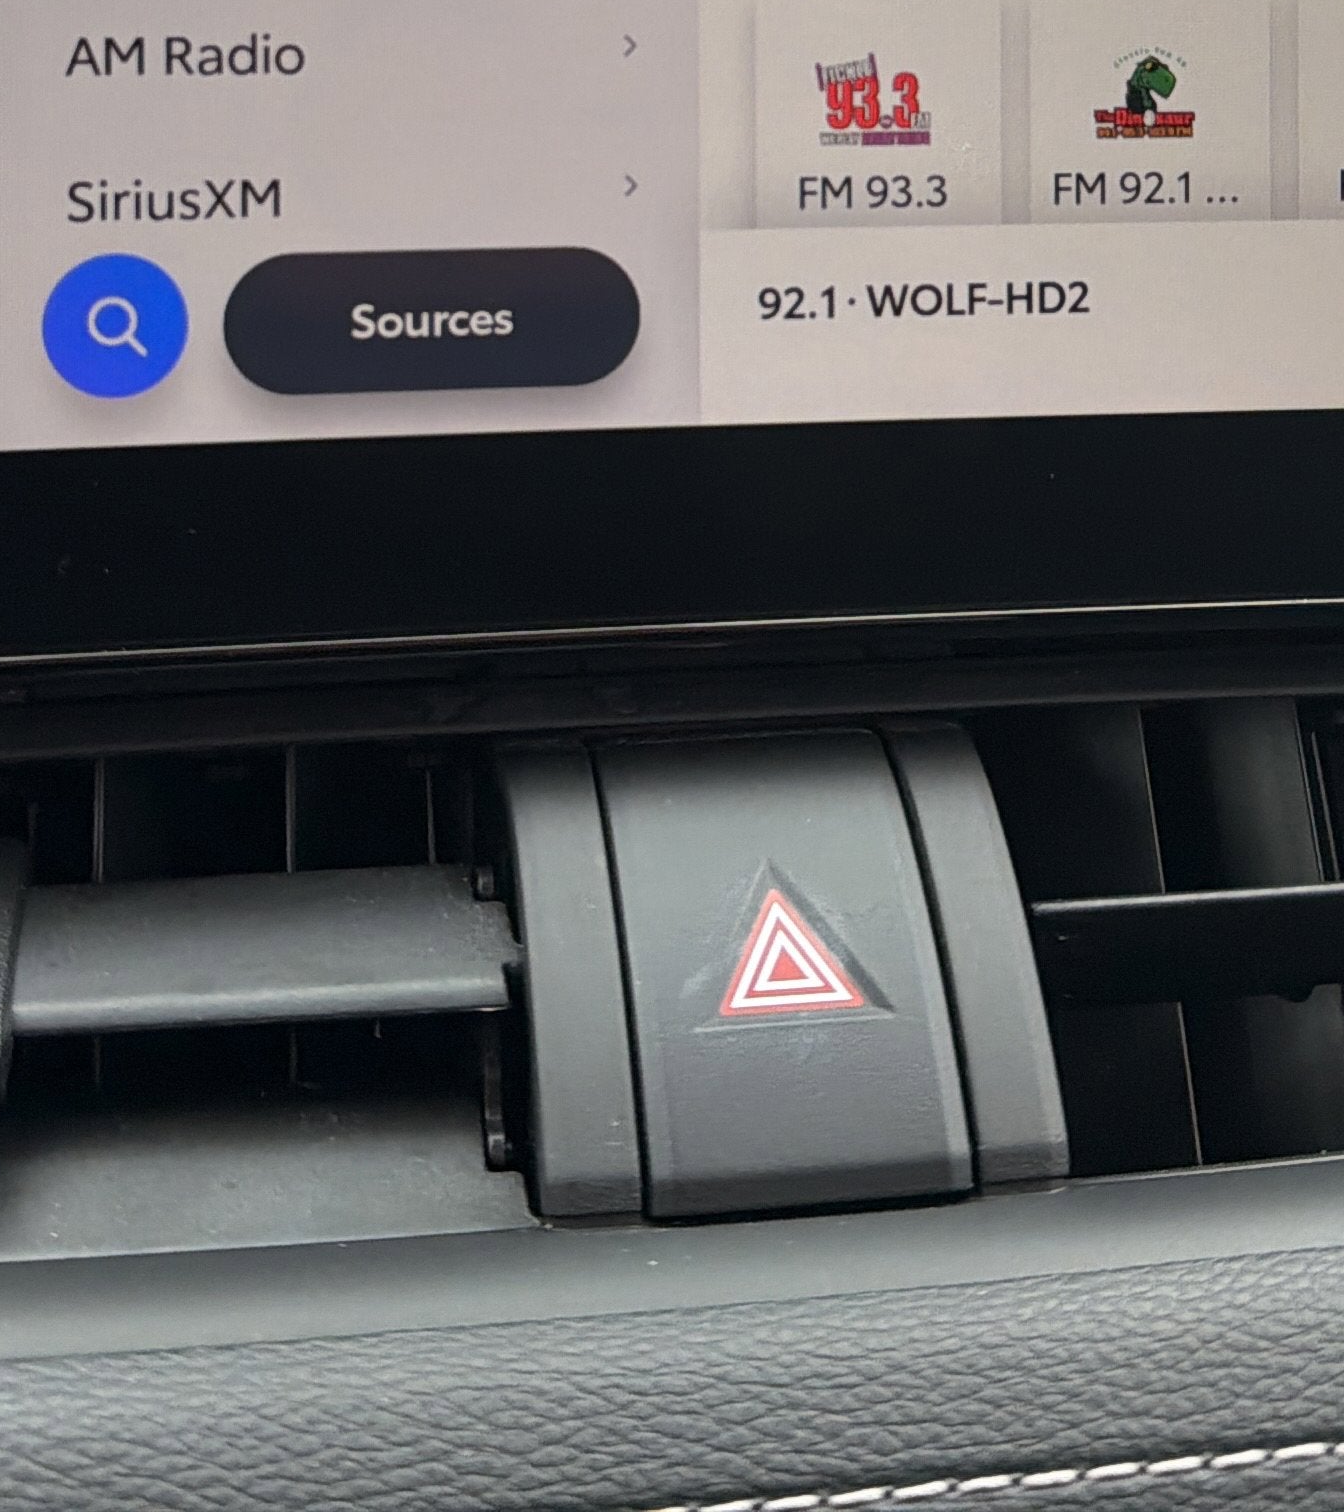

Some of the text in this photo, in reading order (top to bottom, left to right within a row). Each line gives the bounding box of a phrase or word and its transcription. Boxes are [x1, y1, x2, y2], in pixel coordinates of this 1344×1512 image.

[65, 32, 305, 77] AM Radio
[826, 71, 920, 129] 93.3
[67, 178, 281, 223] SiriusXM
[799, 174, 948, 211] FM 93.3
[1054, 172, 1106, 206] FM
[1119, 171, 1190, 205] 92.1
[758, 285, 835, 320] 92.1
[866, 281, 1090, 318] WOLF-HD2
[351, 303, 514, 340] Sources
